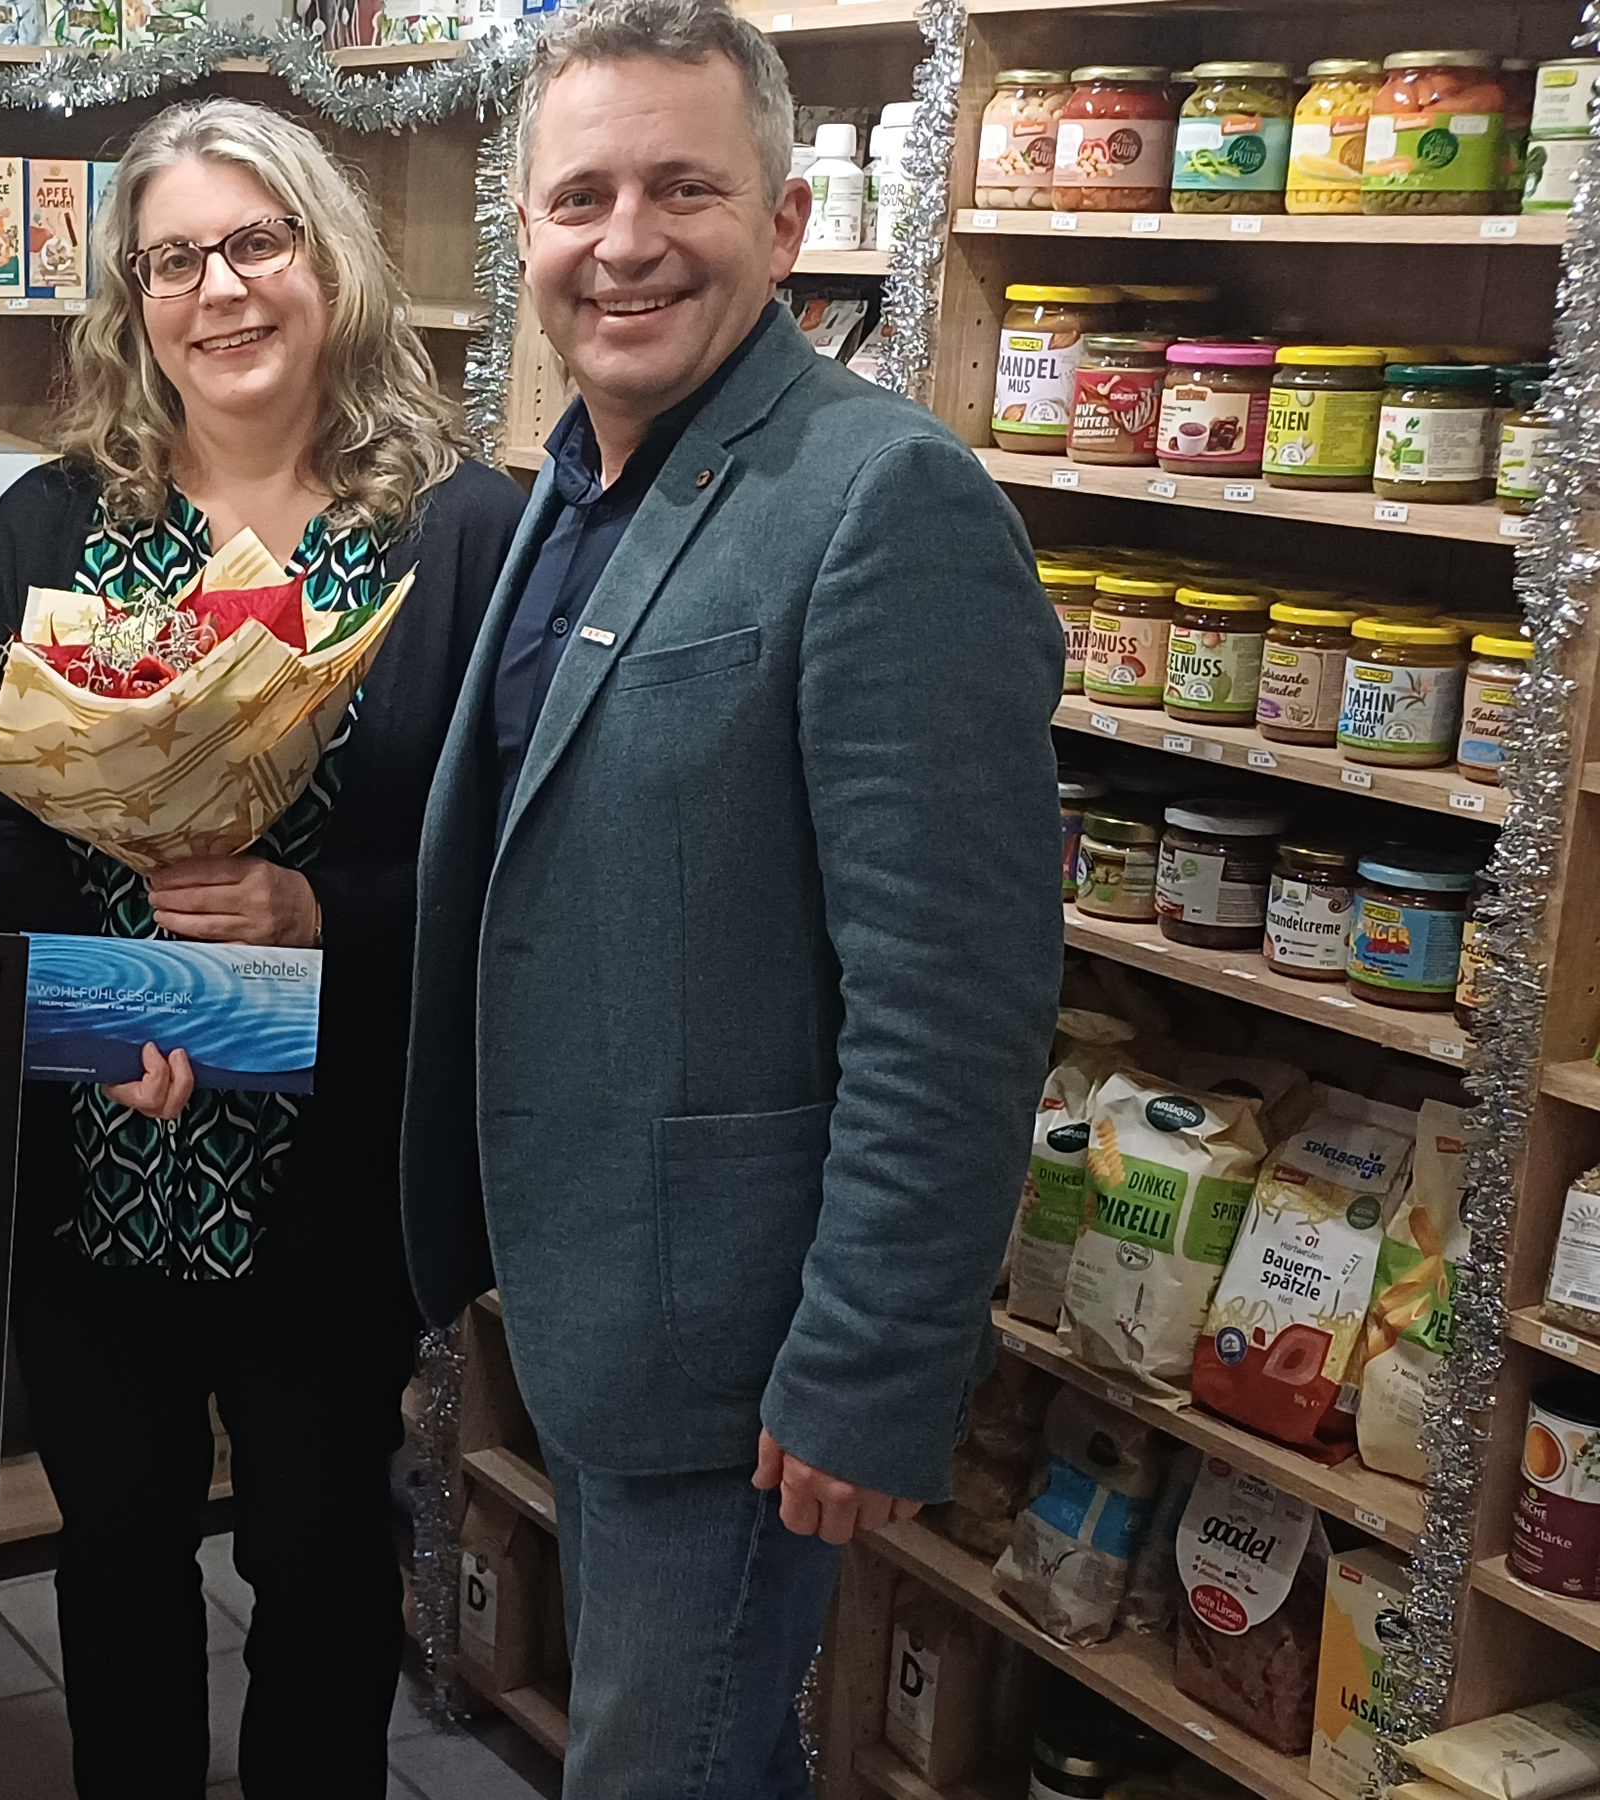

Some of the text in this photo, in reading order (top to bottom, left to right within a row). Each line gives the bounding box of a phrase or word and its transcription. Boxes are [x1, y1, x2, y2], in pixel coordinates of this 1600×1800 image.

[1110, 142, 1138, 158] PUUR
[36, 186, 75, 199] APFEL
[1007, 378, 1031, 394] MUS
[1091, 650, 1109, 665] MUS
[1166, 651, 1223, 678] ELNUSS
[1169, 672, 1186, 687] MUS
[1261, 680, 1302, 698] Mandel
[1348, 686, 1396, 714] TAHIN
[1347, 708, 1385, 726] SESAM
[1352, 724, 1377, 739] MUS
[1267, 912, 1341, 936] mandelcreme
[231, 960, 309, 978] webhotels
[1302, 1138, 1386, 1179] SPIELBERGER
[1127, 1170, 1178, 1202] DINKEL
[1211, 1201, 1245, 1224] SPIR
[1261, 1247, 1332, 1282] Bauern-
[1260, 1269, 1321, 1301] spätzle
[1197, 1514, 1277, 1565] goodel
[1533, 1525, 1573, 1551] Stärke
[1195, 1590, 1243, 1624] Rote Linsen
